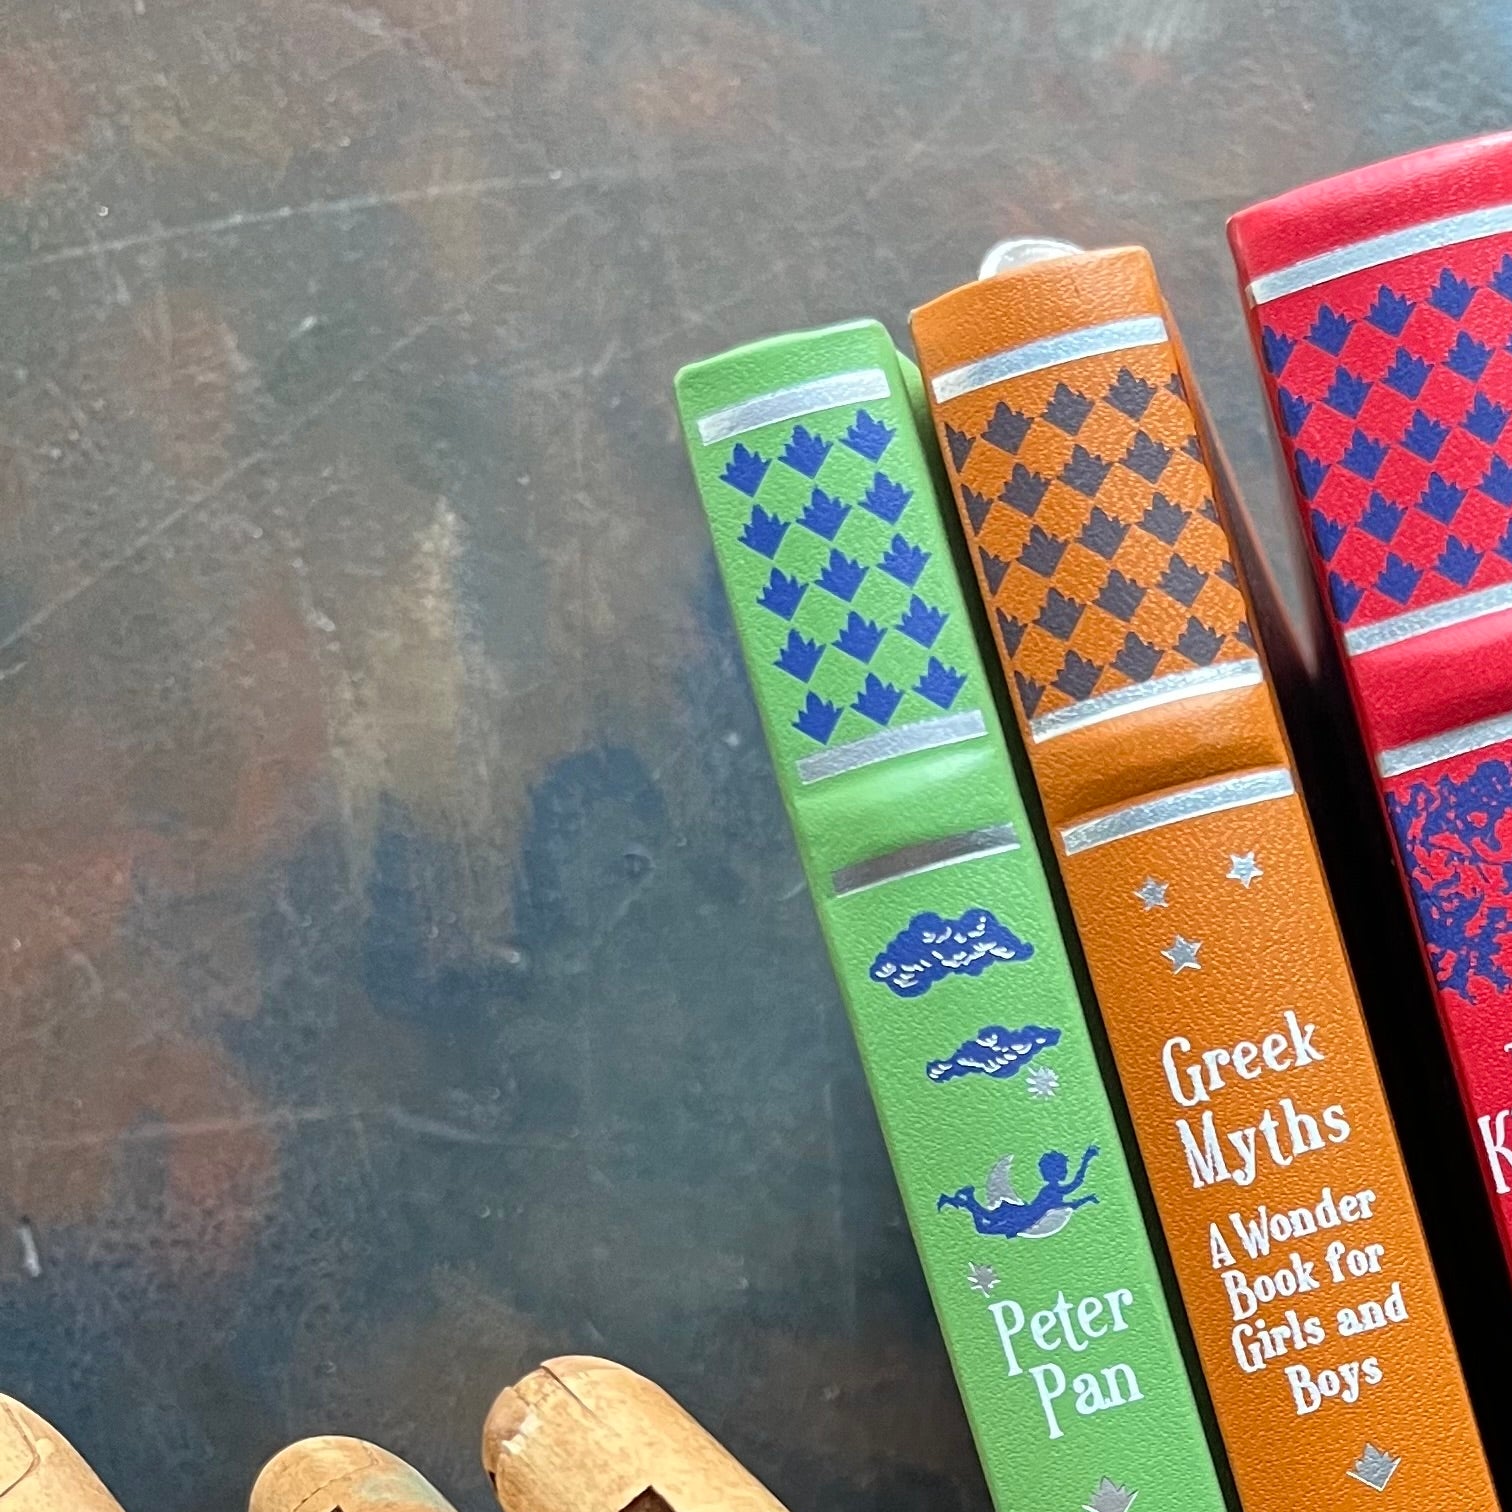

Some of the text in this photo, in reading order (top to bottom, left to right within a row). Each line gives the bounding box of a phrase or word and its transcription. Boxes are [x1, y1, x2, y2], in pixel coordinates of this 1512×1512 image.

[1162, 1009, 1327, 1107] Greek
[1175, 1097, 1351, 1189] Myths
[1209, 1186, 1377, 1270] A Wonder
[1220, 1239, 1385, 1322] Book for
[987, 1288, 1134, 1377] Peter
[1231, 1281, 1409, 1374] Girls and
[1028, 1362, 1145, 1440] Pan
[1284, 1356, 1383, 1416] Boys
